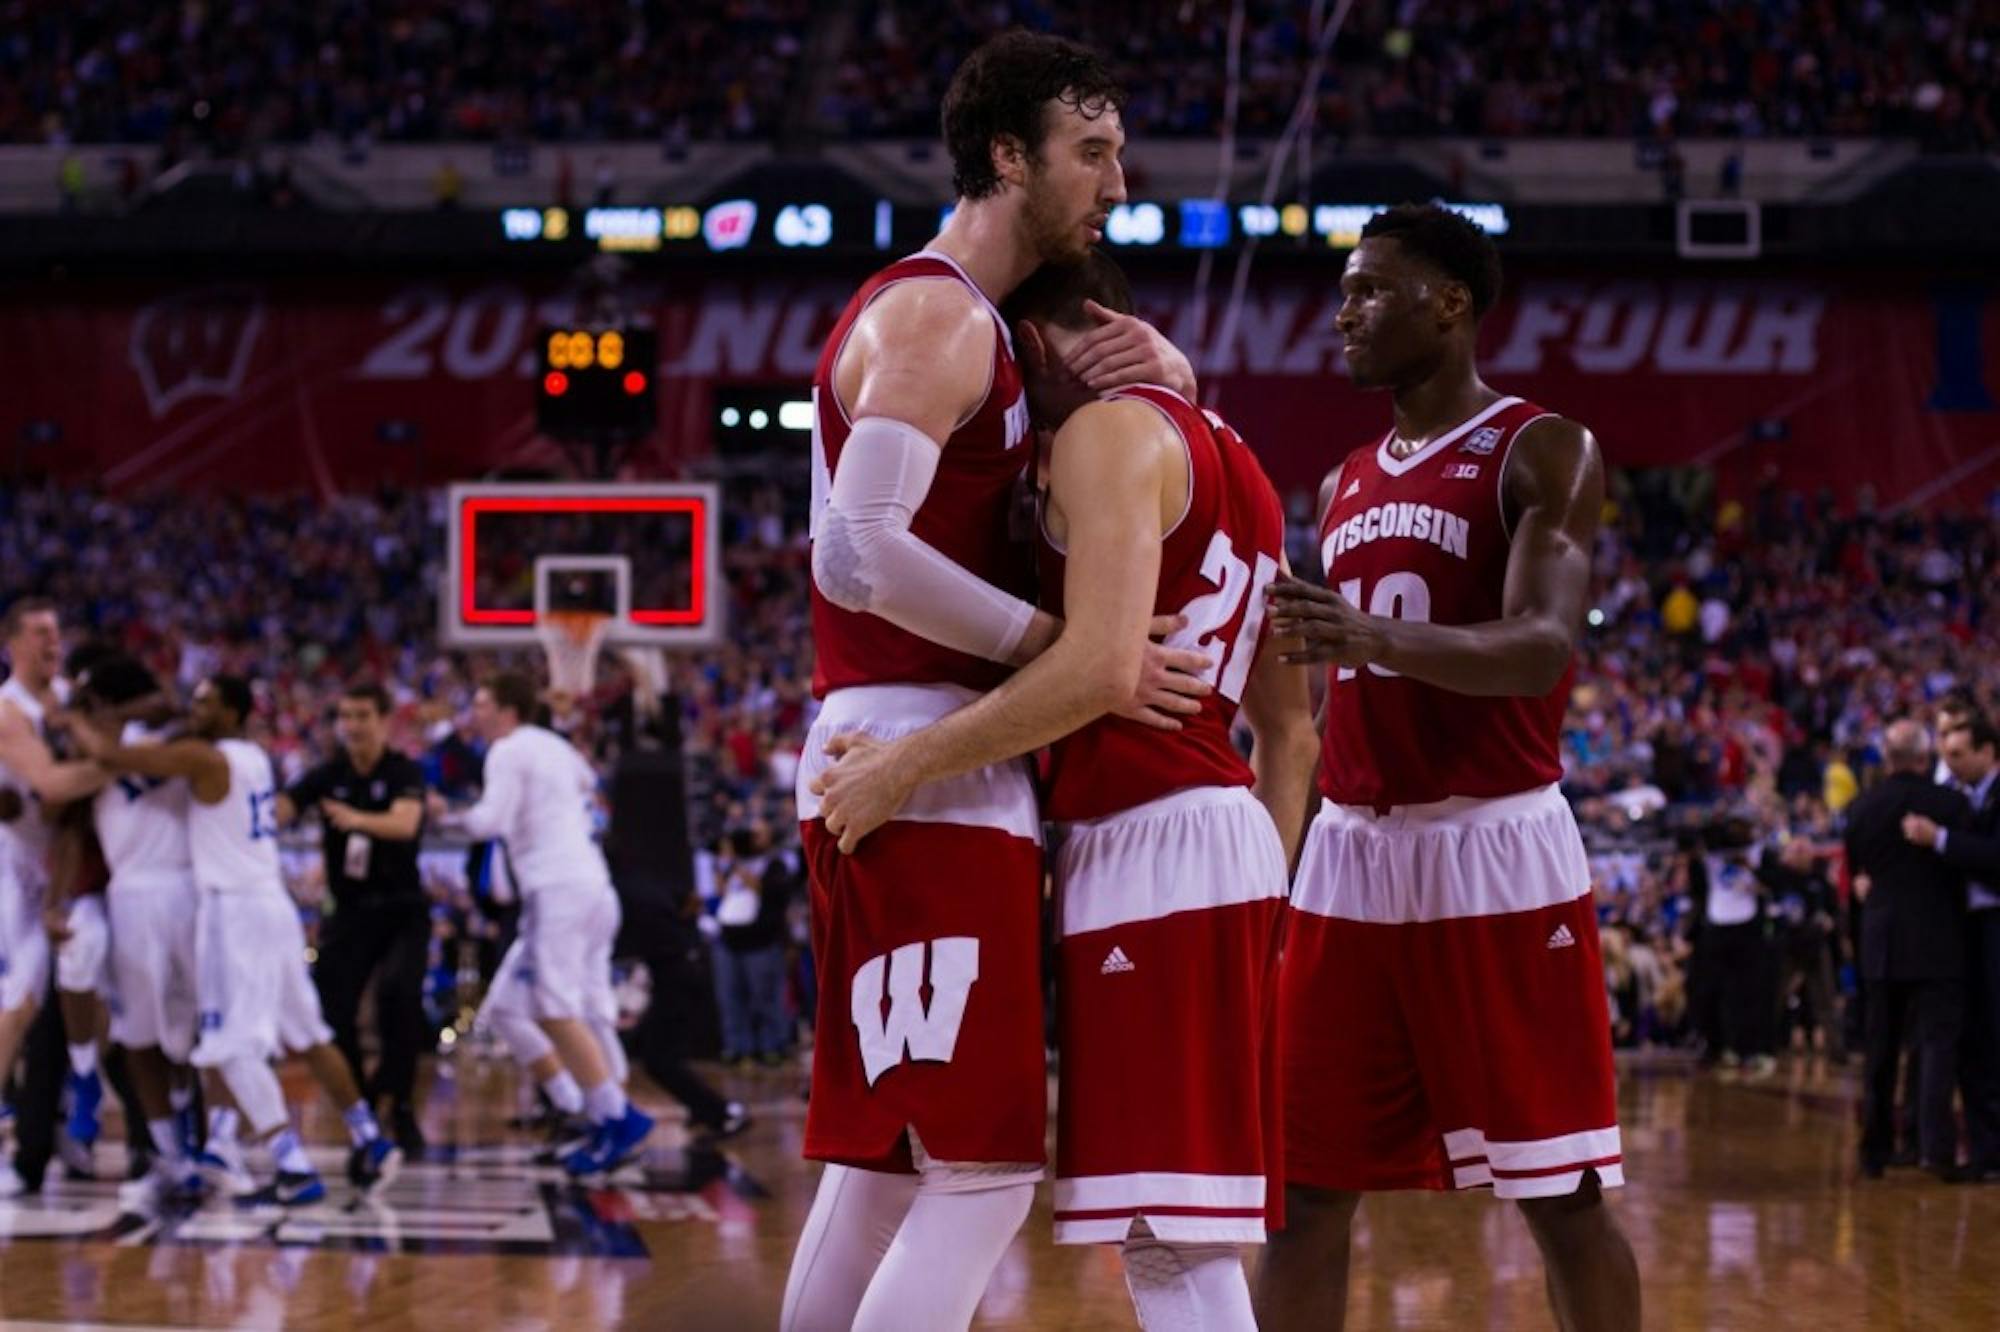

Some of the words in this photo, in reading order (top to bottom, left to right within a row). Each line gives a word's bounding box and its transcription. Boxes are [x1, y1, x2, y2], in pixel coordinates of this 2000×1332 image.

[774, 204, 833, 246] 63
[1484, 279, 1830, 375] FOUR
[1321, 503, 1469, 577] WISCONSIN
[1163, 529, 1279, 704] 21
[851, 937, 979, 1086] W
